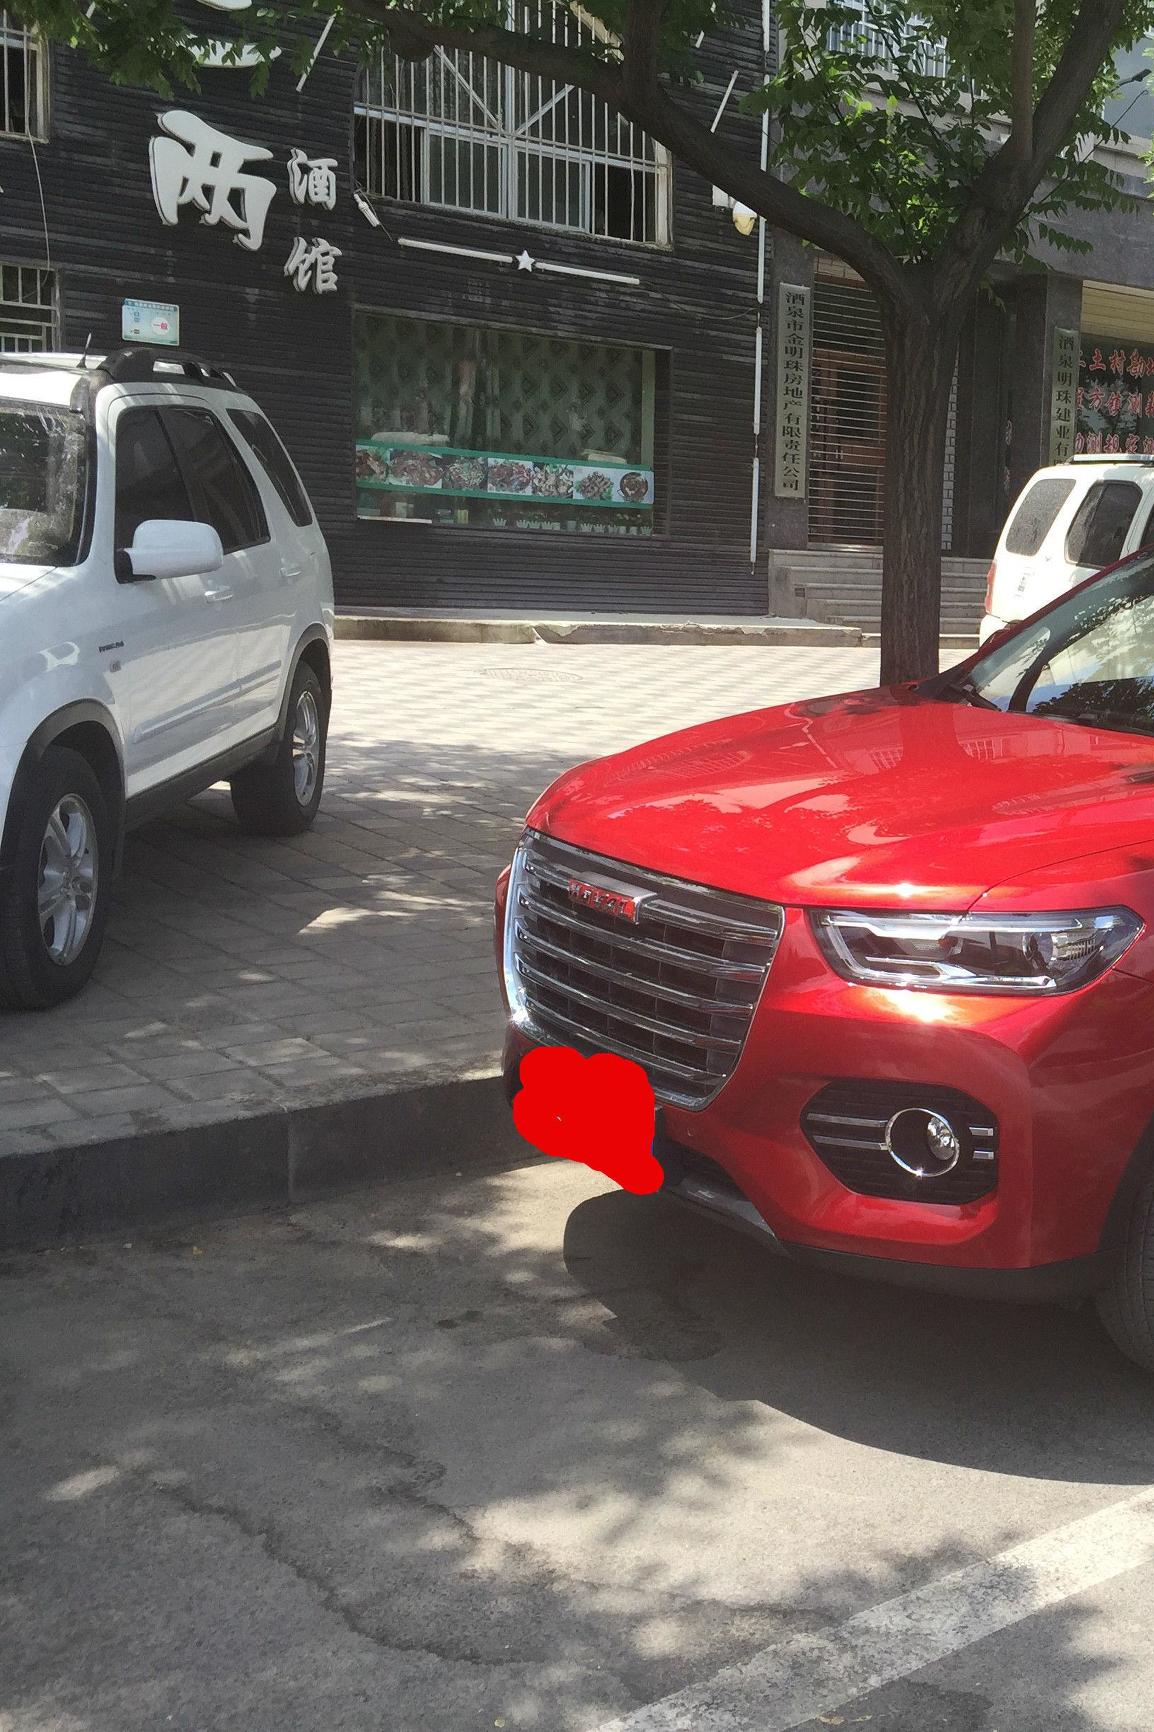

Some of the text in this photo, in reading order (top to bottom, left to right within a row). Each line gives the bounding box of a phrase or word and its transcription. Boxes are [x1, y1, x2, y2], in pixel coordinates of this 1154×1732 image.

[284, 148, 342, 294] 酒馆
[783, 291, 805, 490] 酒泉市金明珠房地产有限责任公司
